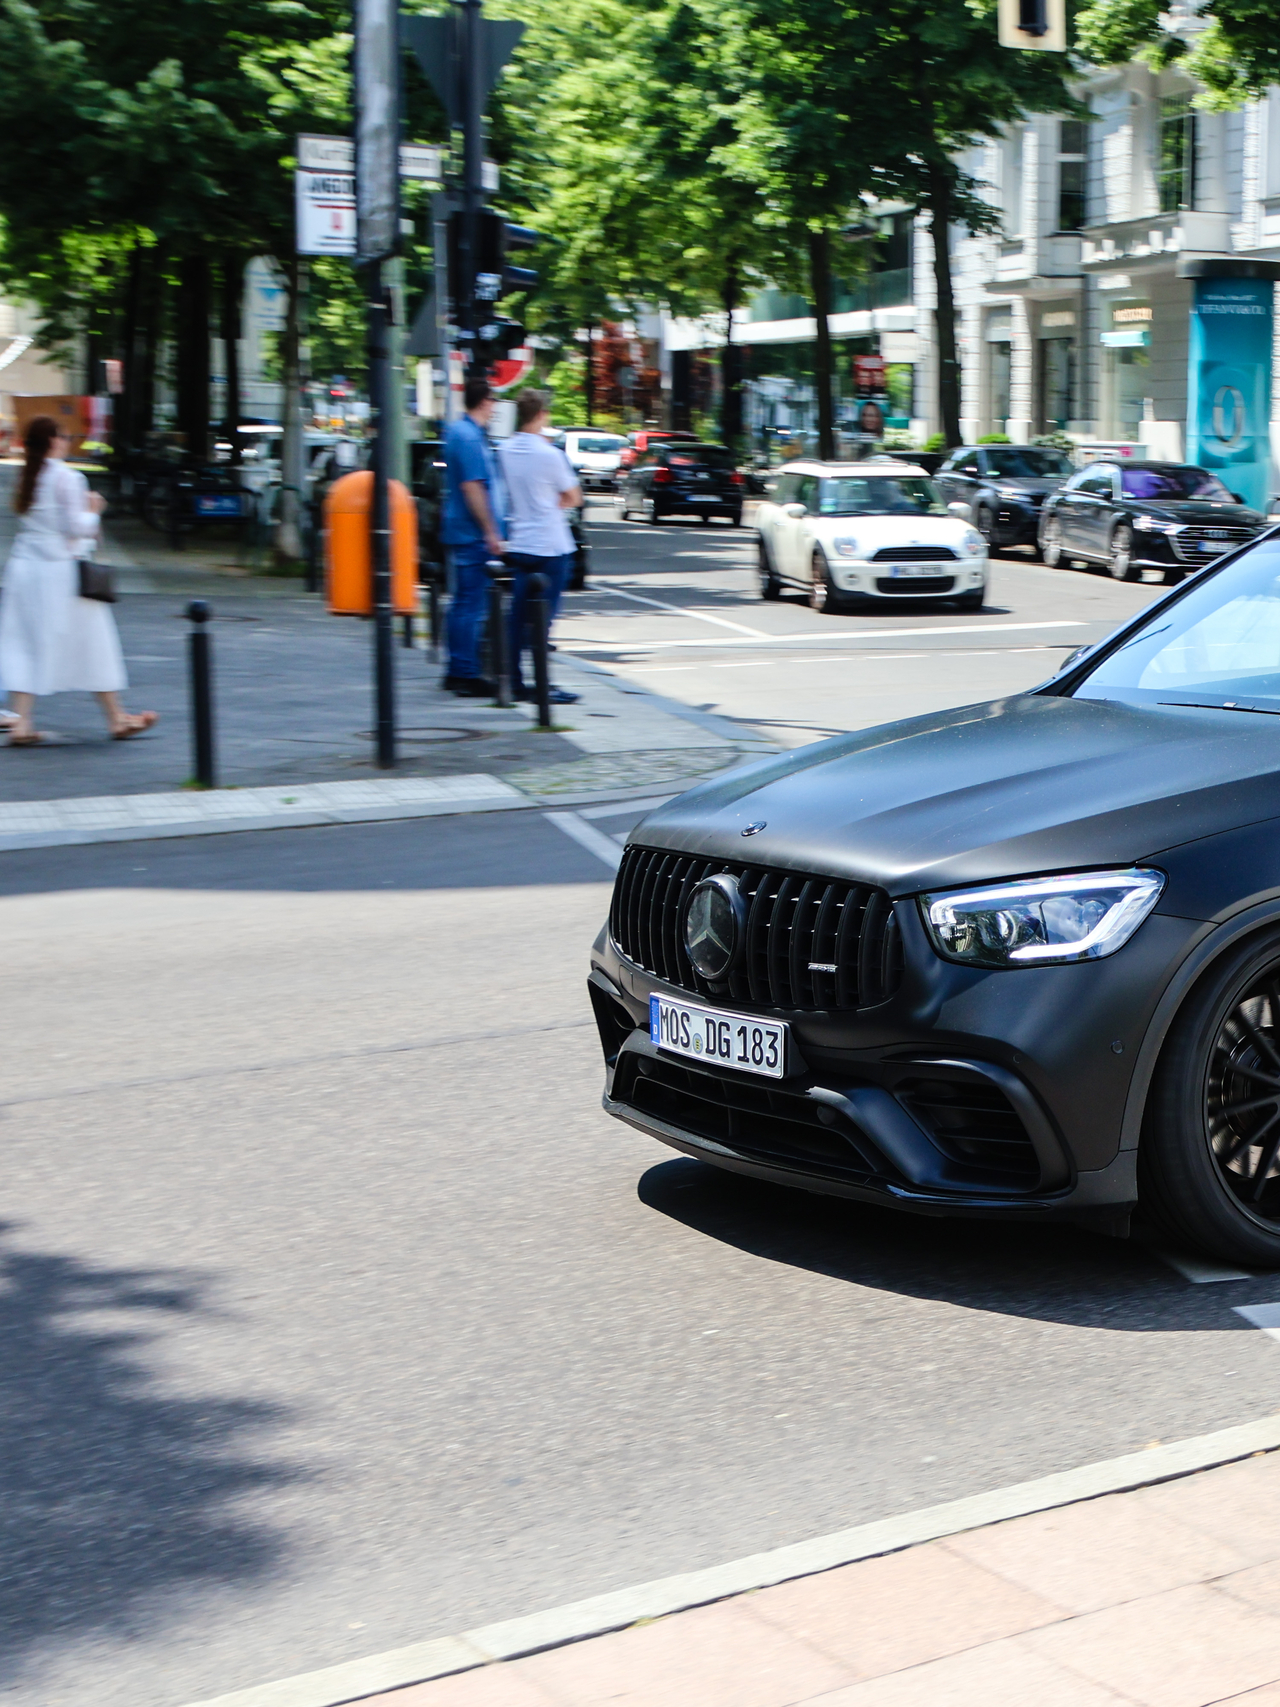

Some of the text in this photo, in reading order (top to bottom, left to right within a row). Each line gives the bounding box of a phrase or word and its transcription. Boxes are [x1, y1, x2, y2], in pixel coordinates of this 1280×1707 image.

[660, 1005, 779, 1068] MOS DG 183
